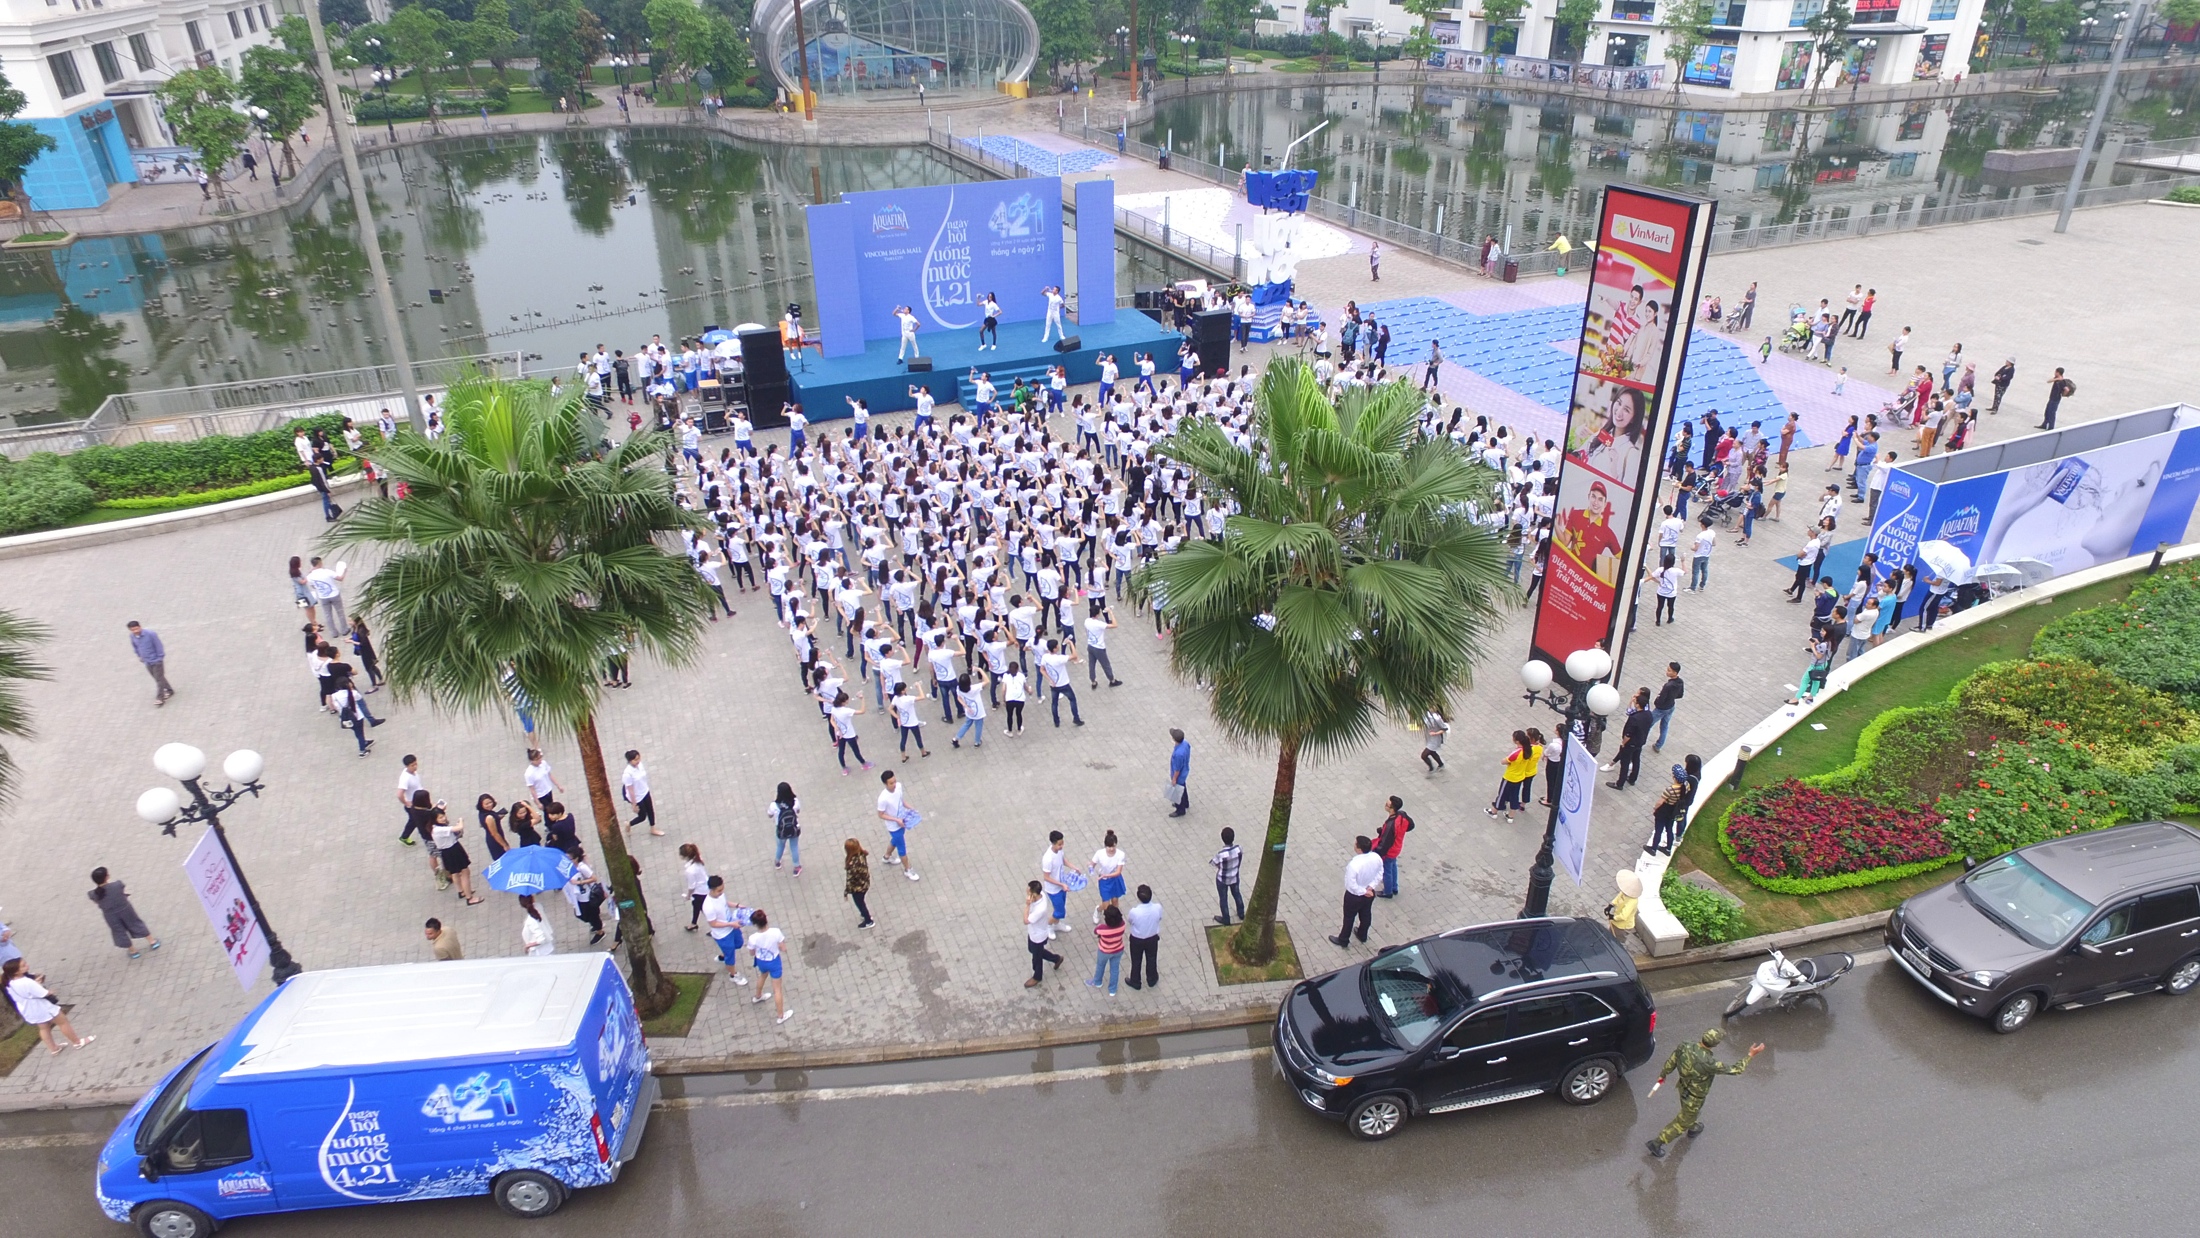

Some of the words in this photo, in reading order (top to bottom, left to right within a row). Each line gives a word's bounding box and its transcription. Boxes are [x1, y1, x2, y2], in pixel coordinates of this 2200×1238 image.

[872, 212, 910, 232] AQUAFINA
[946, 219, 969, 231] ngày
[948, 228, 968, 245] hội
[1629, 222, 1670, 245] VinMart
[863, 250, 889, 259] VINCOM
[888, 248, 906, 257] MEGA
[906, 246, 922, 255] MALL
[933, 245, 972, 264] uống
[991, 247, 1010, 257] tháng
[1011, 246, 1017, 254] 4
[1018, 245, 1035, 255] ngày
[1036, 243, 1045, 252] 21
[928, 261, 972, 283] nước
[929, 281, 974, 308] 4.21
[1901, 518, 1919, 533] hội
[1904, 512, 1922, 524] ngày
[1936, 511, 1980, 540] AQUAFINA
[1877, 533, 1913, 557] nước
[1886, 525, 1918, 547] uống
[1552, 554, 1568, 571] Diện
[1567, 568, 1584, 583] mạo
[1873, 546, 1908, 571] 4.21
[1569, 581, 1593, 604] nghiệm
[506, 872, 545, 890] AQUAFINA
[348, 1109, 381, 1122] ngày
[350, 1118, 381, 1134] hội
[331, 1132, 390, 1150] uống
[326, 1147, 393, 1167] nước
[217, 1174, 273, 1196] AQUAFINA
[334, 1162, 400, 1188] 4.21
